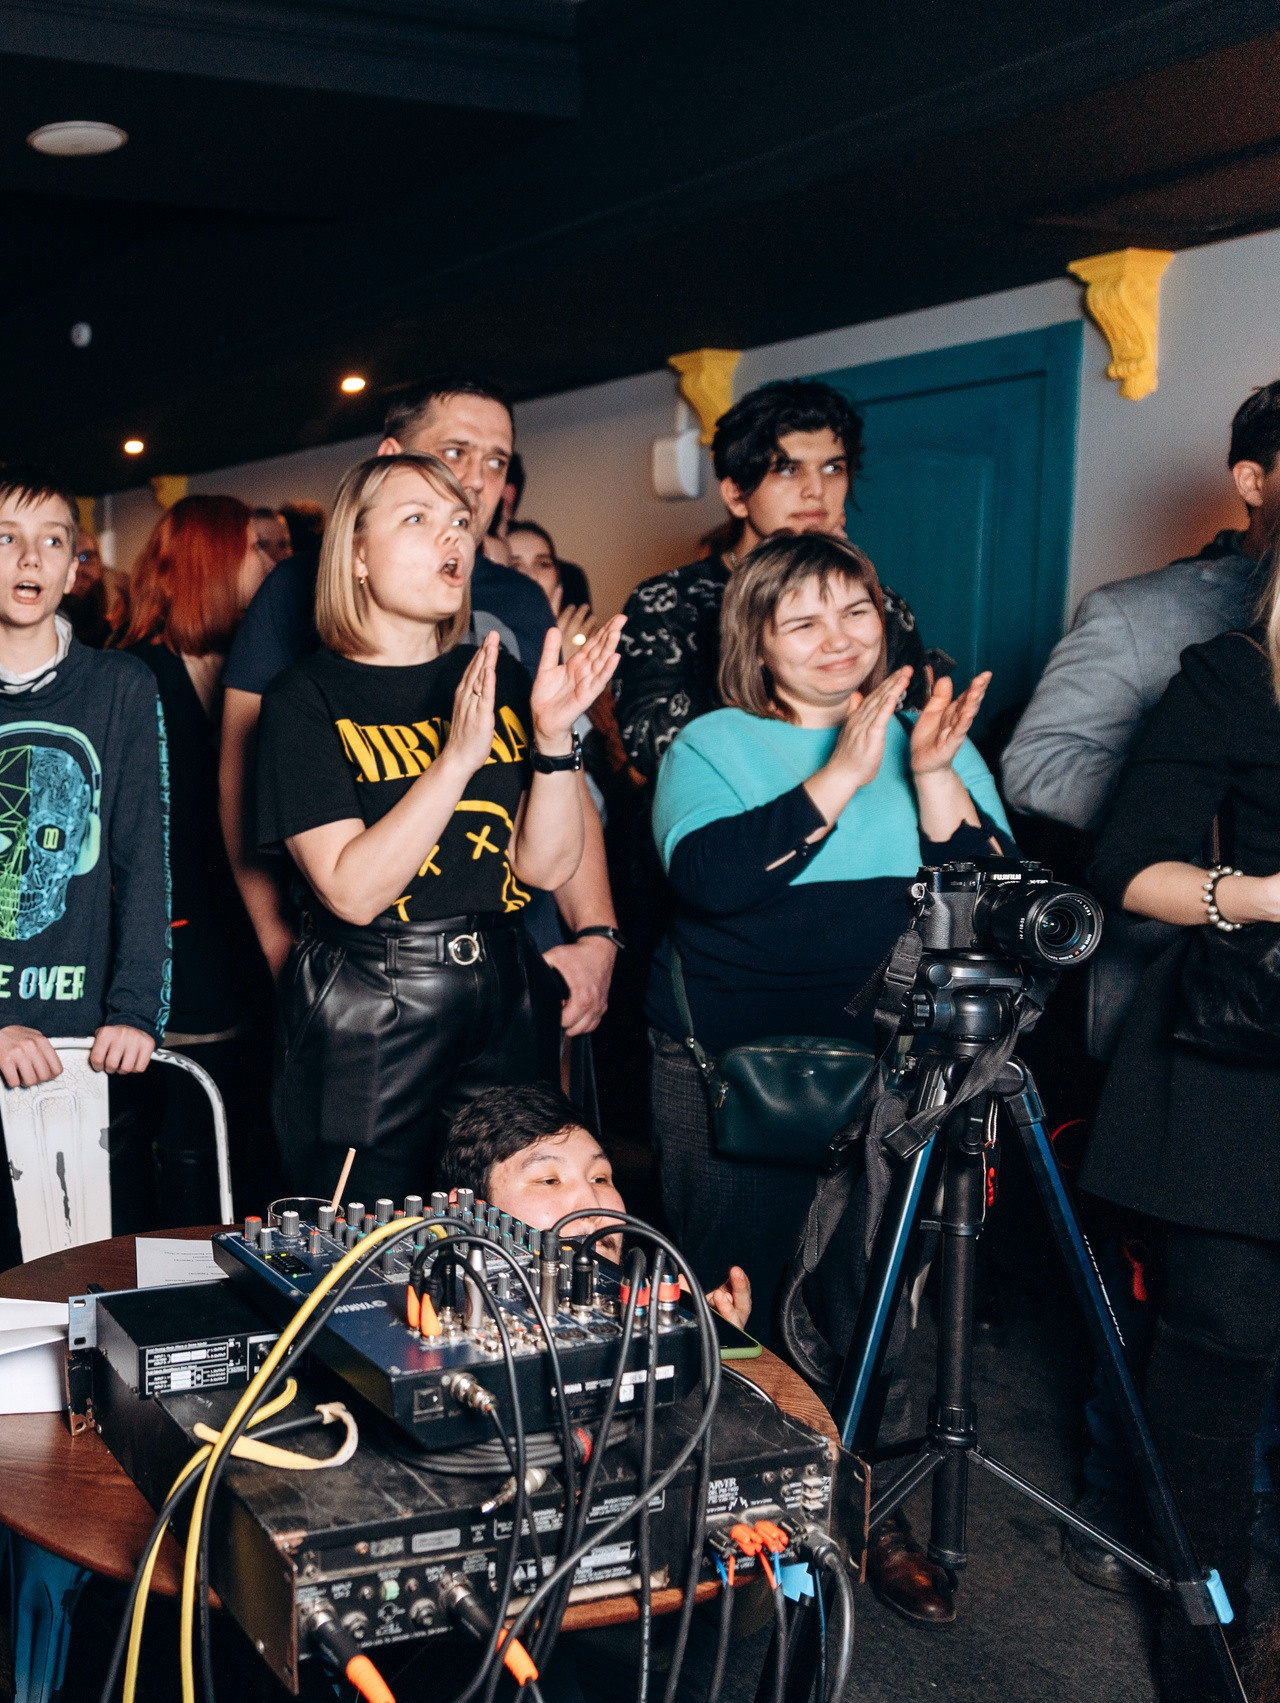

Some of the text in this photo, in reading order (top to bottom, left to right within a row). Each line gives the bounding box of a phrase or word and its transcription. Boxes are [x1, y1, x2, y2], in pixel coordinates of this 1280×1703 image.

[335, 705, 528, 782] NIRVNA
[993, 873, 1022, 881] FUJIFILM
[19, 965, 86, 1000] OVER
[333, 1301, 376, 1314] YAMAH
